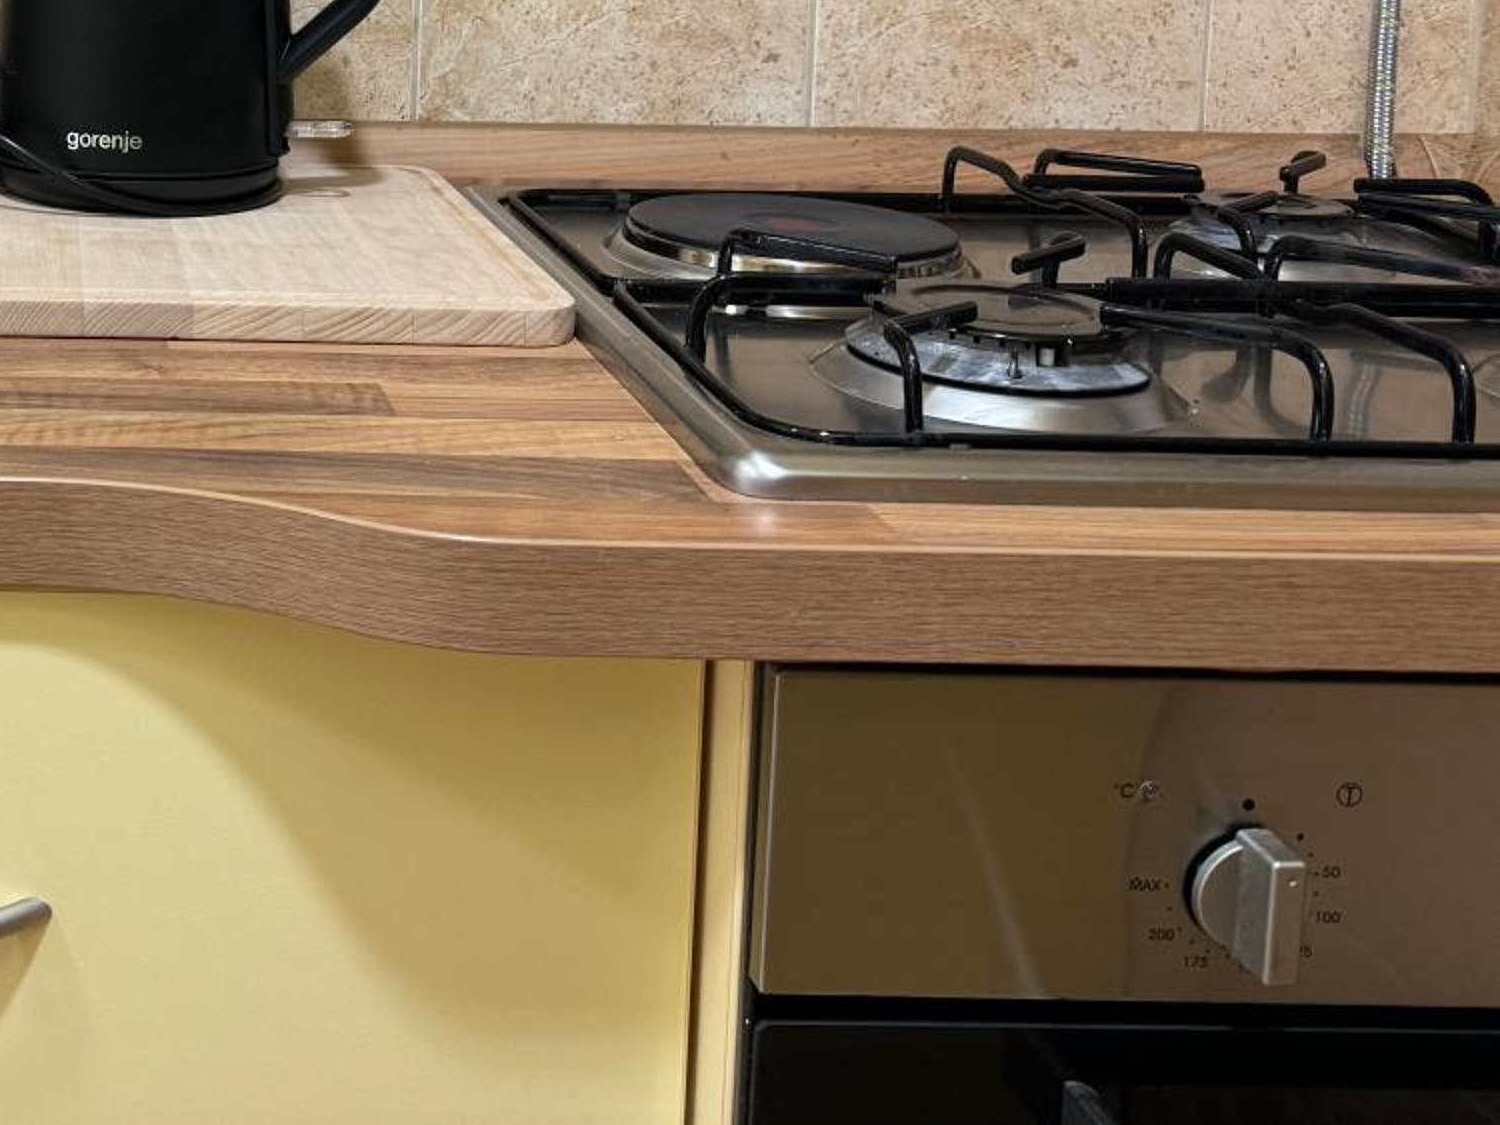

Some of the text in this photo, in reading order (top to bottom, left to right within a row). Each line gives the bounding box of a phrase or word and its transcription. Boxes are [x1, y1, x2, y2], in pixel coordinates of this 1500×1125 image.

[67, 130, 143, 154] gorenje
[1322, 865, 1341, 879] 50
[1129, 876, 1162, 891] MAX
[1315, 910, 1341, 924] 100
